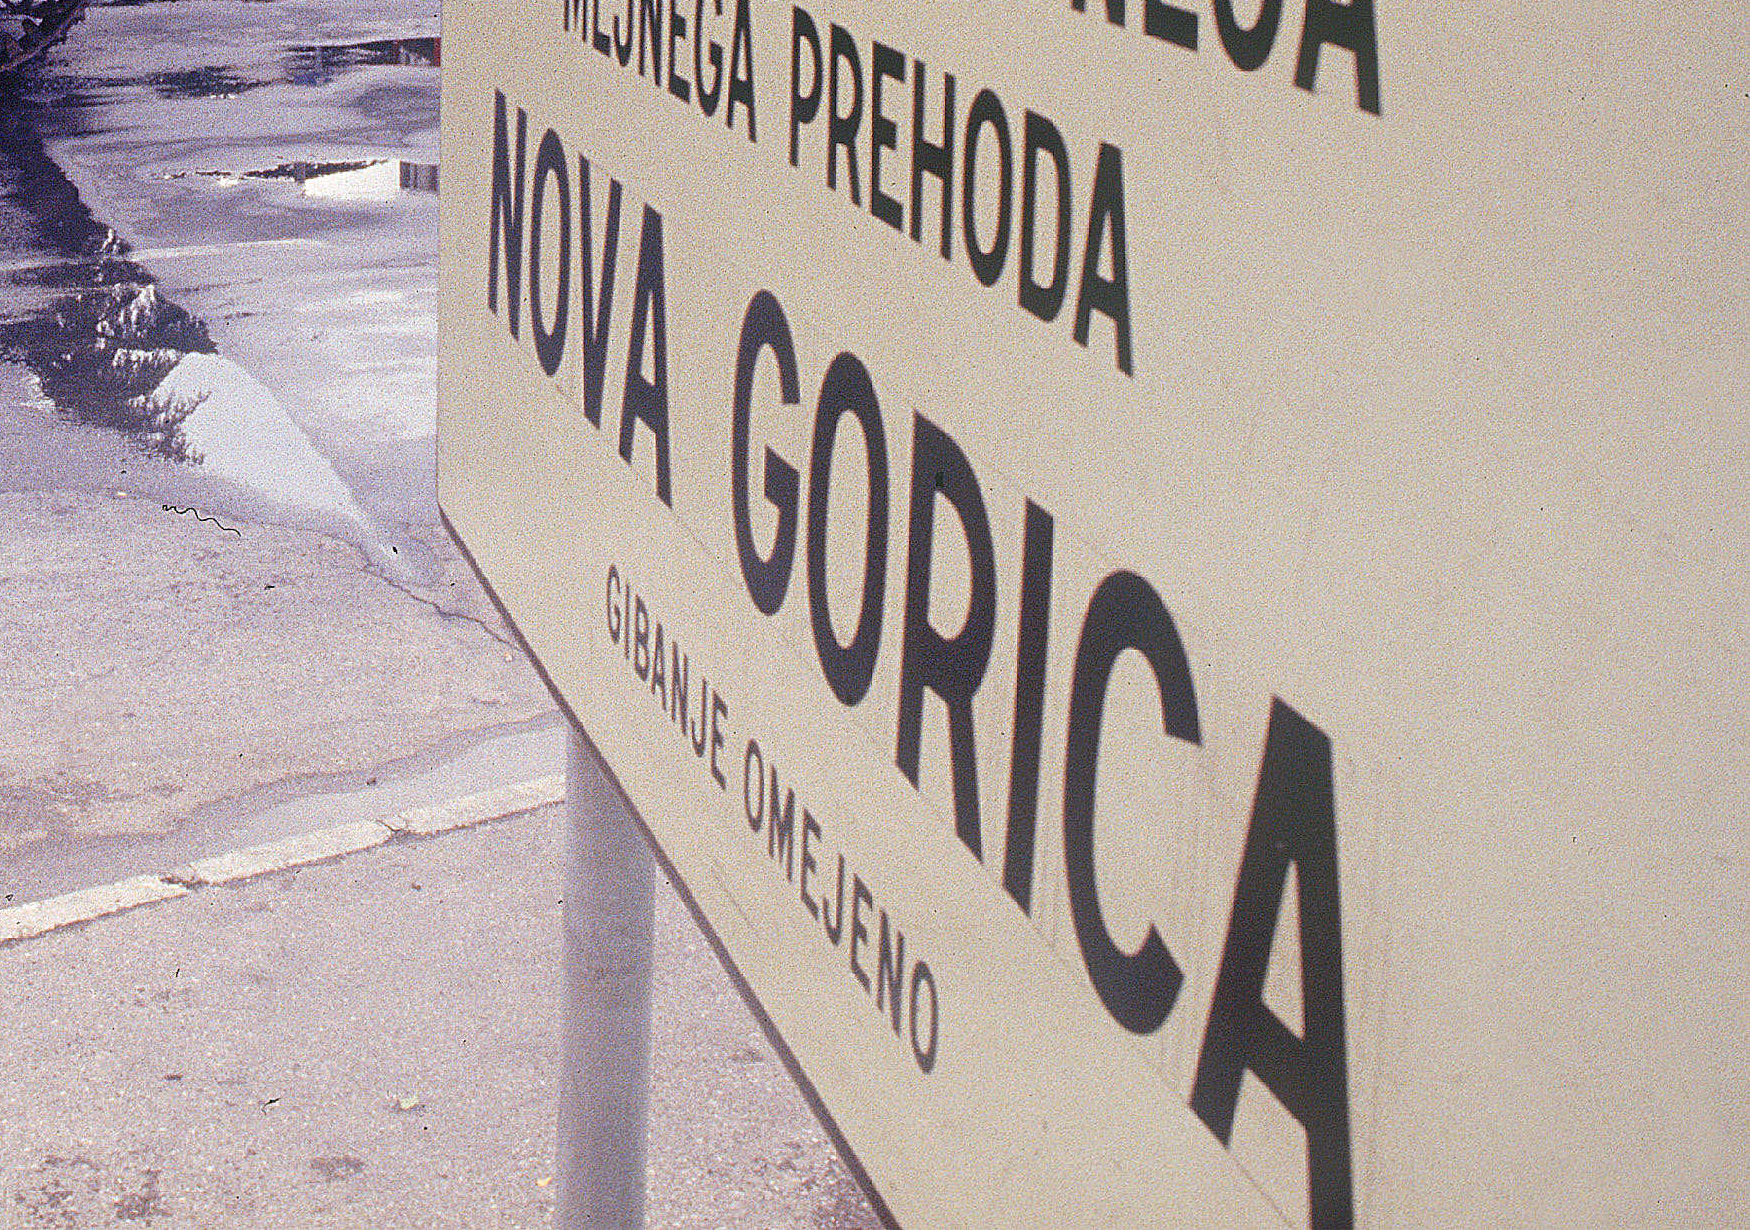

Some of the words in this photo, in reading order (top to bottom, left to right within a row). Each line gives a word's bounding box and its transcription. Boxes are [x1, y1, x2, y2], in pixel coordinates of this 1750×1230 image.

[789, 2, 1135, 378] PREHODA
[487, 86, 674, 511] NOVA
[730, 288, 1356, 1230] GORICA
[603, 562, 729, 794] GIBANJE
[742, 737, 941, 1076] OMEJENO
